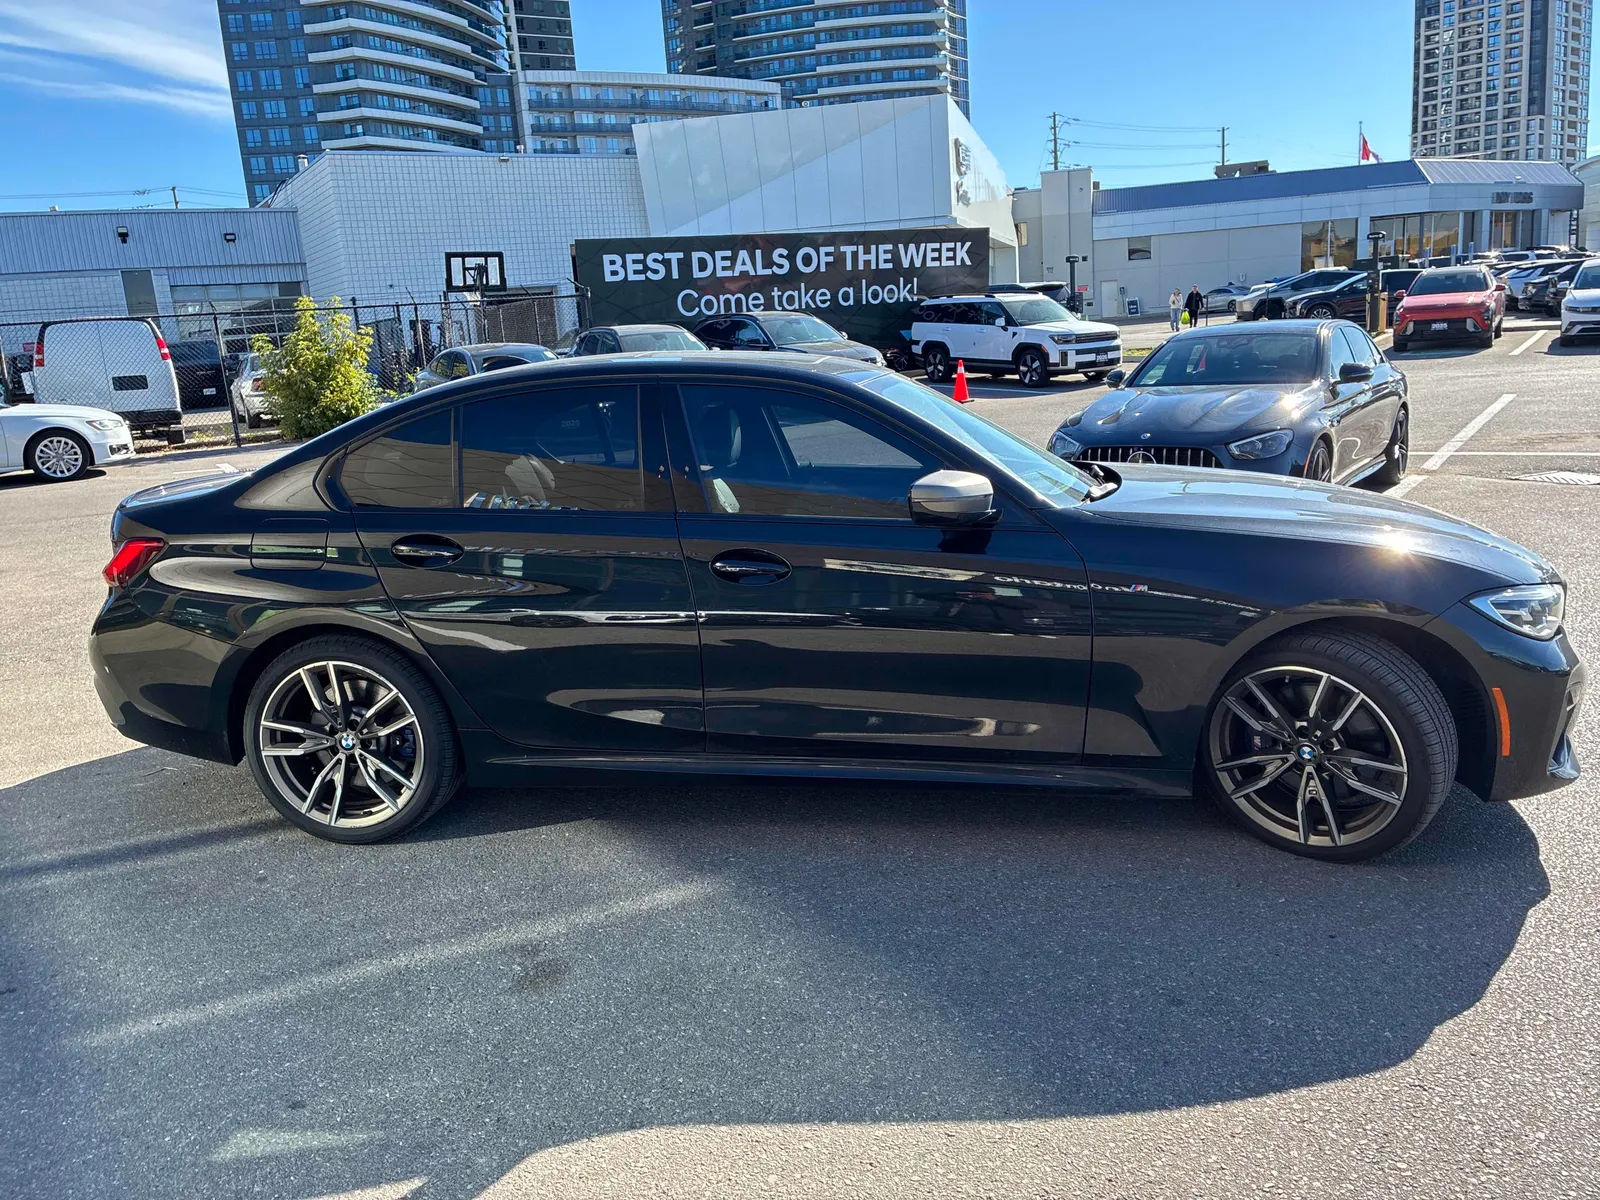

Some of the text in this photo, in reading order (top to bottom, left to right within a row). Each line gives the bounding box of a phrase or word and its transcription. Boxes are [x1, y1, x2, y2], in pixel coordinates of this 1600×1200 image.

[602, 241, 972, 282] BEST DEALS OF THE WEEK
[677, 277, 918, 317] Come take a look!
